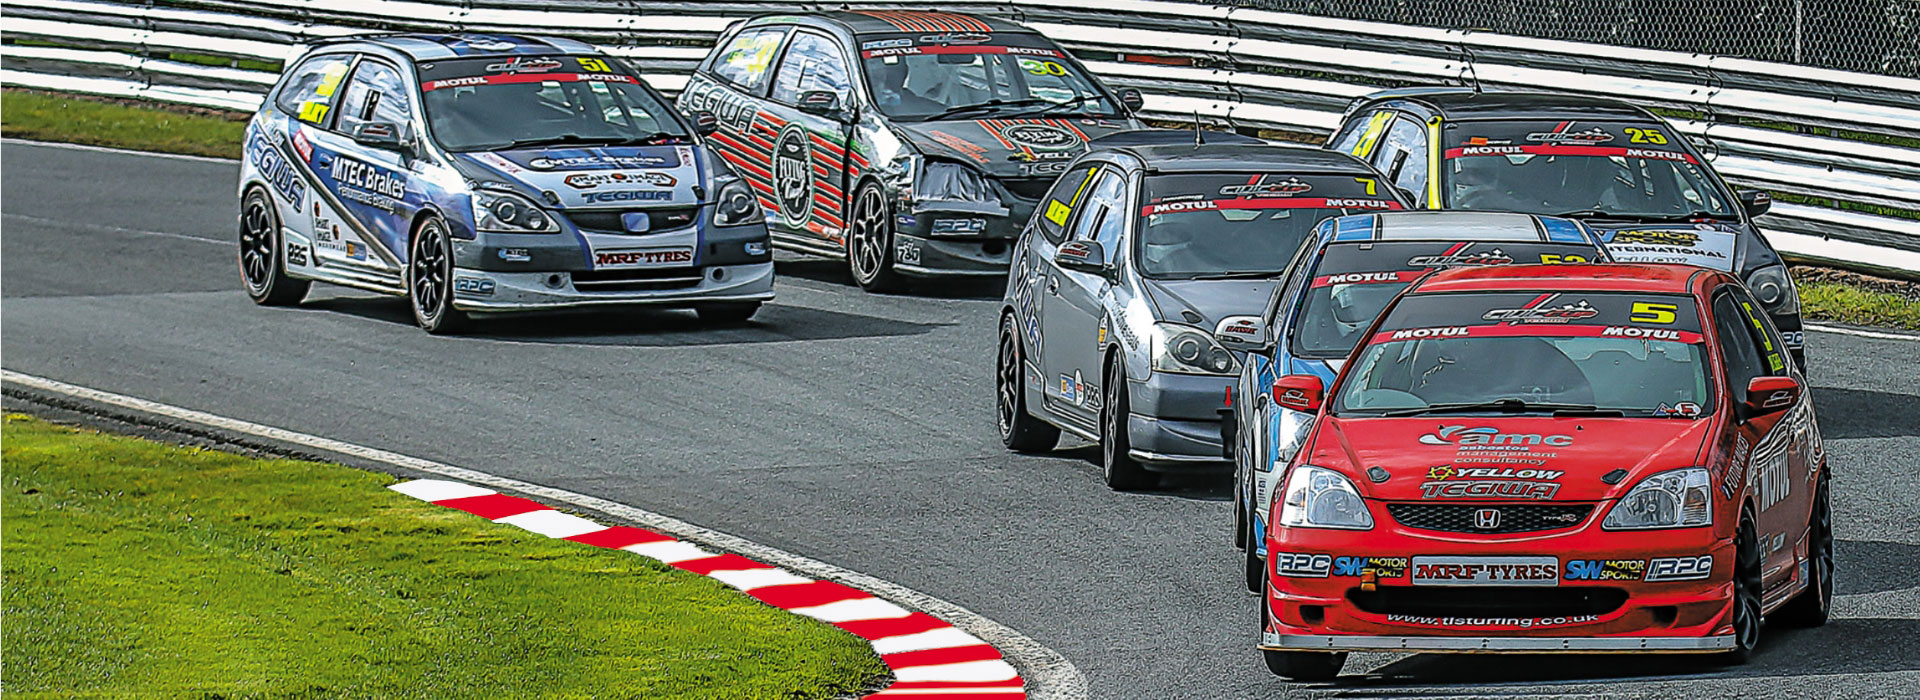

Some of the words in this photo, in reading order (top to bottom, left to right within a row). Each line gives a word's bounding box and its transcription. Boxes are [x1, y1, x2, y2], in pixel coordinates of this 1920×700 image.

[870, 48, 922, 57] MOTUL
[1006, 47, 1057, 57] MOTUL
[576, 57, 613, 73] 51
[1022, 60, 1066, 77] 30
[433, 76, 488, 88] MOTUL
[577, 73, 630, 83] MOTUL
[1624, 127, 1668, 145] 25
[1463, 146, 1524, 155] MOTUL
[1627, 149, 1687, 161] MOTUL
[332, 156, 366, 187] MTEC
[365, 166, 406, 200] Brakes
[1354, 177, 1377, 195] 7
[581, 190, 674, 204] TEGIWA
[1326, 199, 1390, 209] MOTUL
[1153, 200, 1218, 213] MOTUL
[595, 251, 644, 266] MRF
[645, 250, 692, 264] TYRES
[1327, 272, 1399, 284] MOTUL
[1630, 302, 1678, 324] 5
[1392, 327, 1470, 339] MOTUL
[1602, 326, 1681, 341] MOTUL
[1459, 433, 1574, 447] amc
[1453, 457, 1548, 466] consultancy
[1456, 468, 1566, 479] YELLOW
[1420, 481, 1563, 499] TEGIWA
[1279, 555, 1329, 571] RPC
[1333, 556, 1369, 576] SW
[1368, 557, 1408, 568] MOTOR
[1564, 559, 1605, 580] SW
[1605, 560, 1645, 570] MOTOR
[1657, 557, 1713, 575] RPC
[1415, 564, 1484, 580] MRF
[1485, 564, 1557, 580] TYRES
[1599, 570, 1640, 580] SPORTS
